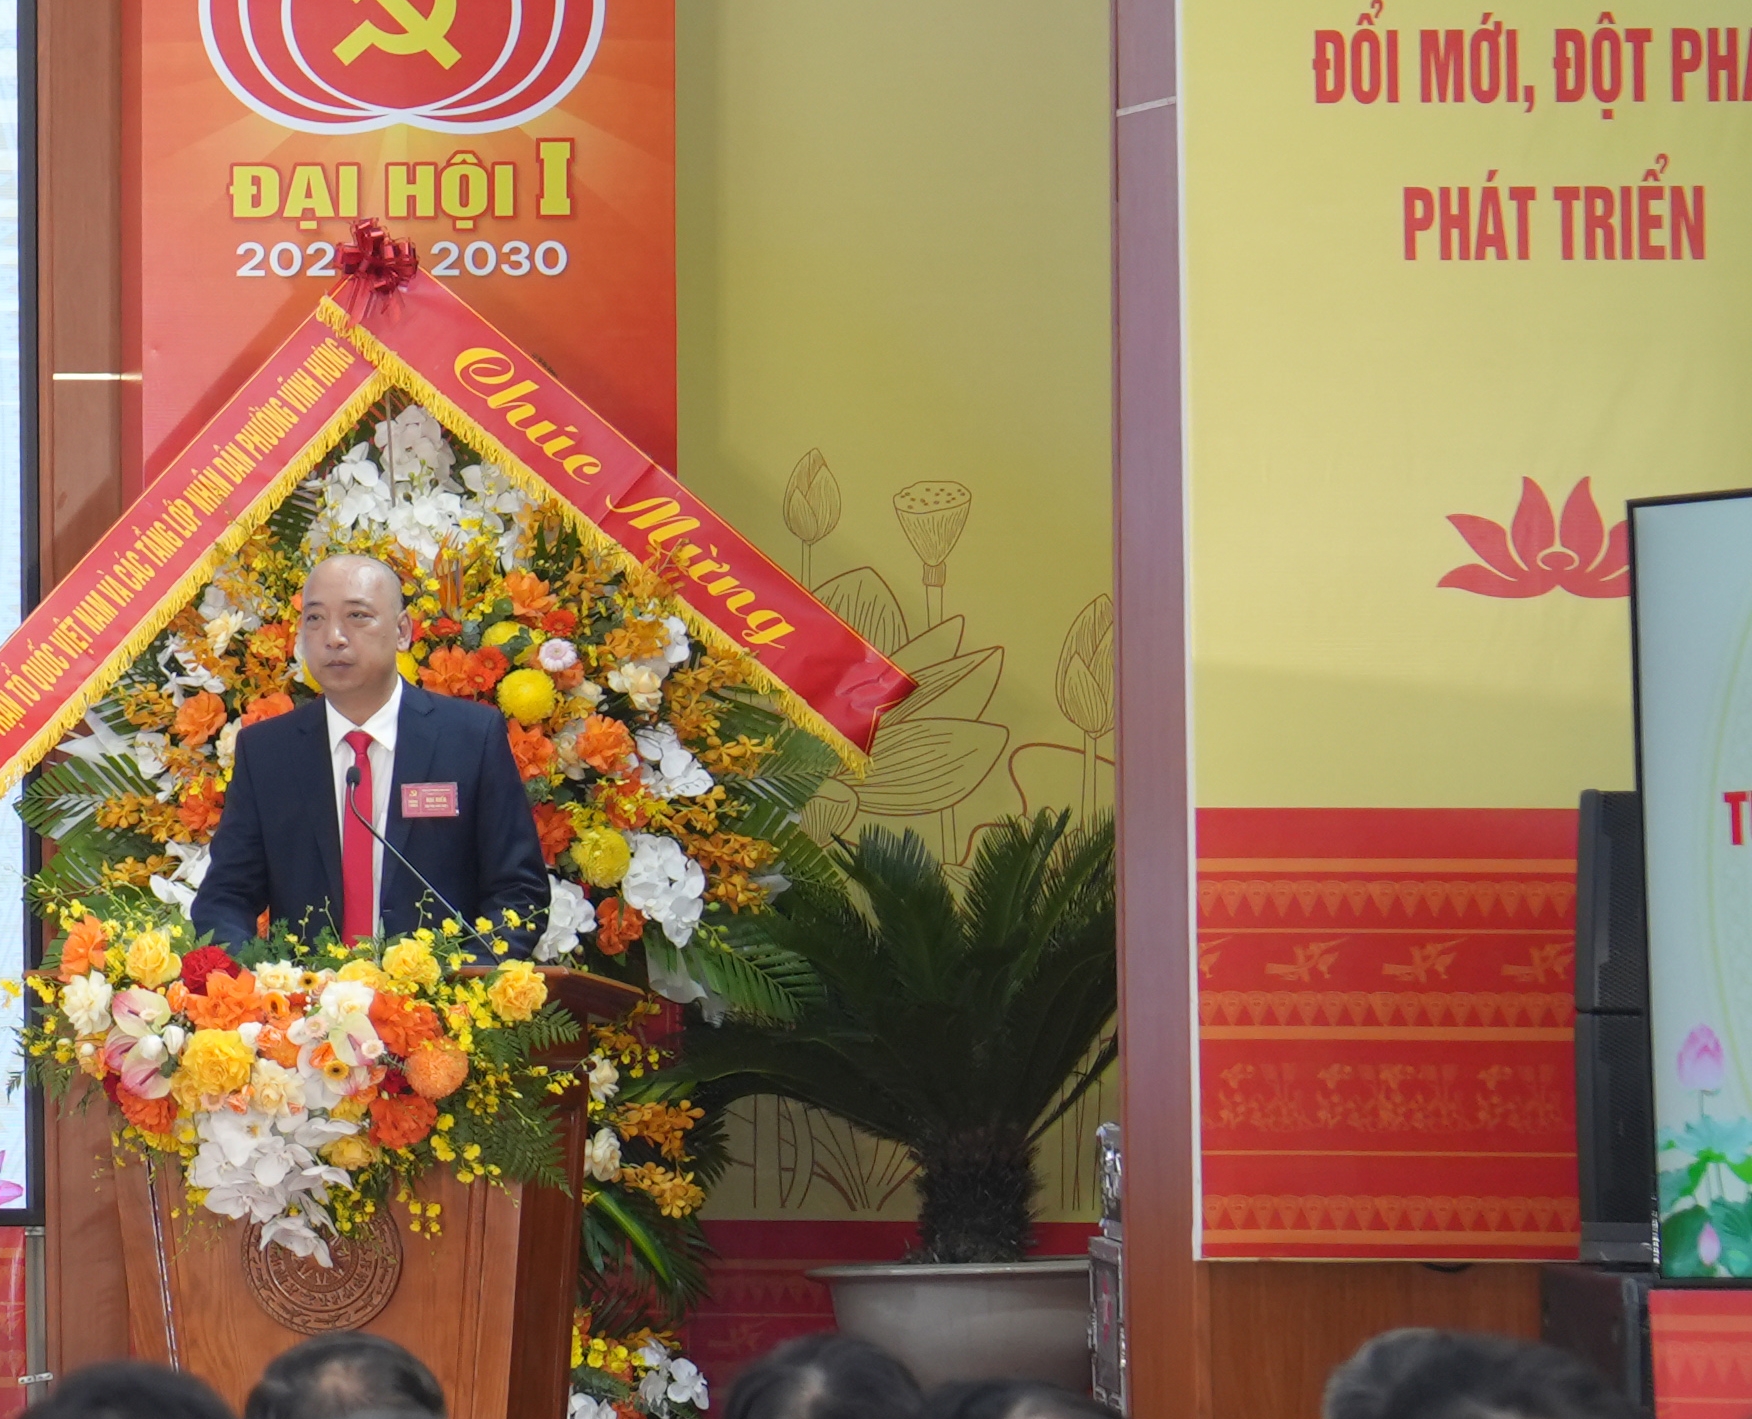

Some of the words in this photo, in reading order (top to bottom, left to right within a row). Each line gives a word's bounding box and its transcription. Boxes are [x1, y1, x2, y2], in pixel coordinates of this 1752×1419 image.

[1420, 12, 1536, 112] MỚI,
[1553, 11, 1653, 120] ĐỘT
[1671, 27, 1752, 102] PH
[229, 164, 358, 230] ĐẠI
[386, 152, 515, 231] HỘI
[537, 139, 573, 217] I
[1403, 169, 1537, 261] PHÁT
[1553, 153, 1706, 261] TRIỂN
[235, 240, 337, 278] 202
[428, 239, 569, 277] 2030
[304, 337, 356, 387] HƯNG
[278, 369, 326, 414] VĨNH
[235, 397, 300, 460] PHƯỜNG
[212, 442, 256, 484] DÂN
[183, 466, 235, 516] NHÂN
[454, 347, 602, 485] Chúc
[605, 494, 795, 650] Mừng
[161, 498, 203, 539] LỚP
[133, 520, 184, 567] TẦNG
[96, 575, 135, 607] VÀ
[113, 550, 156, 591] CÁC
[72, 590, 119, 635] NAM
[49, 615, 94, 659] VIỆT
[4, 661, 42, 707] TỔ
[20, 639, 71, 692] QUỐC
